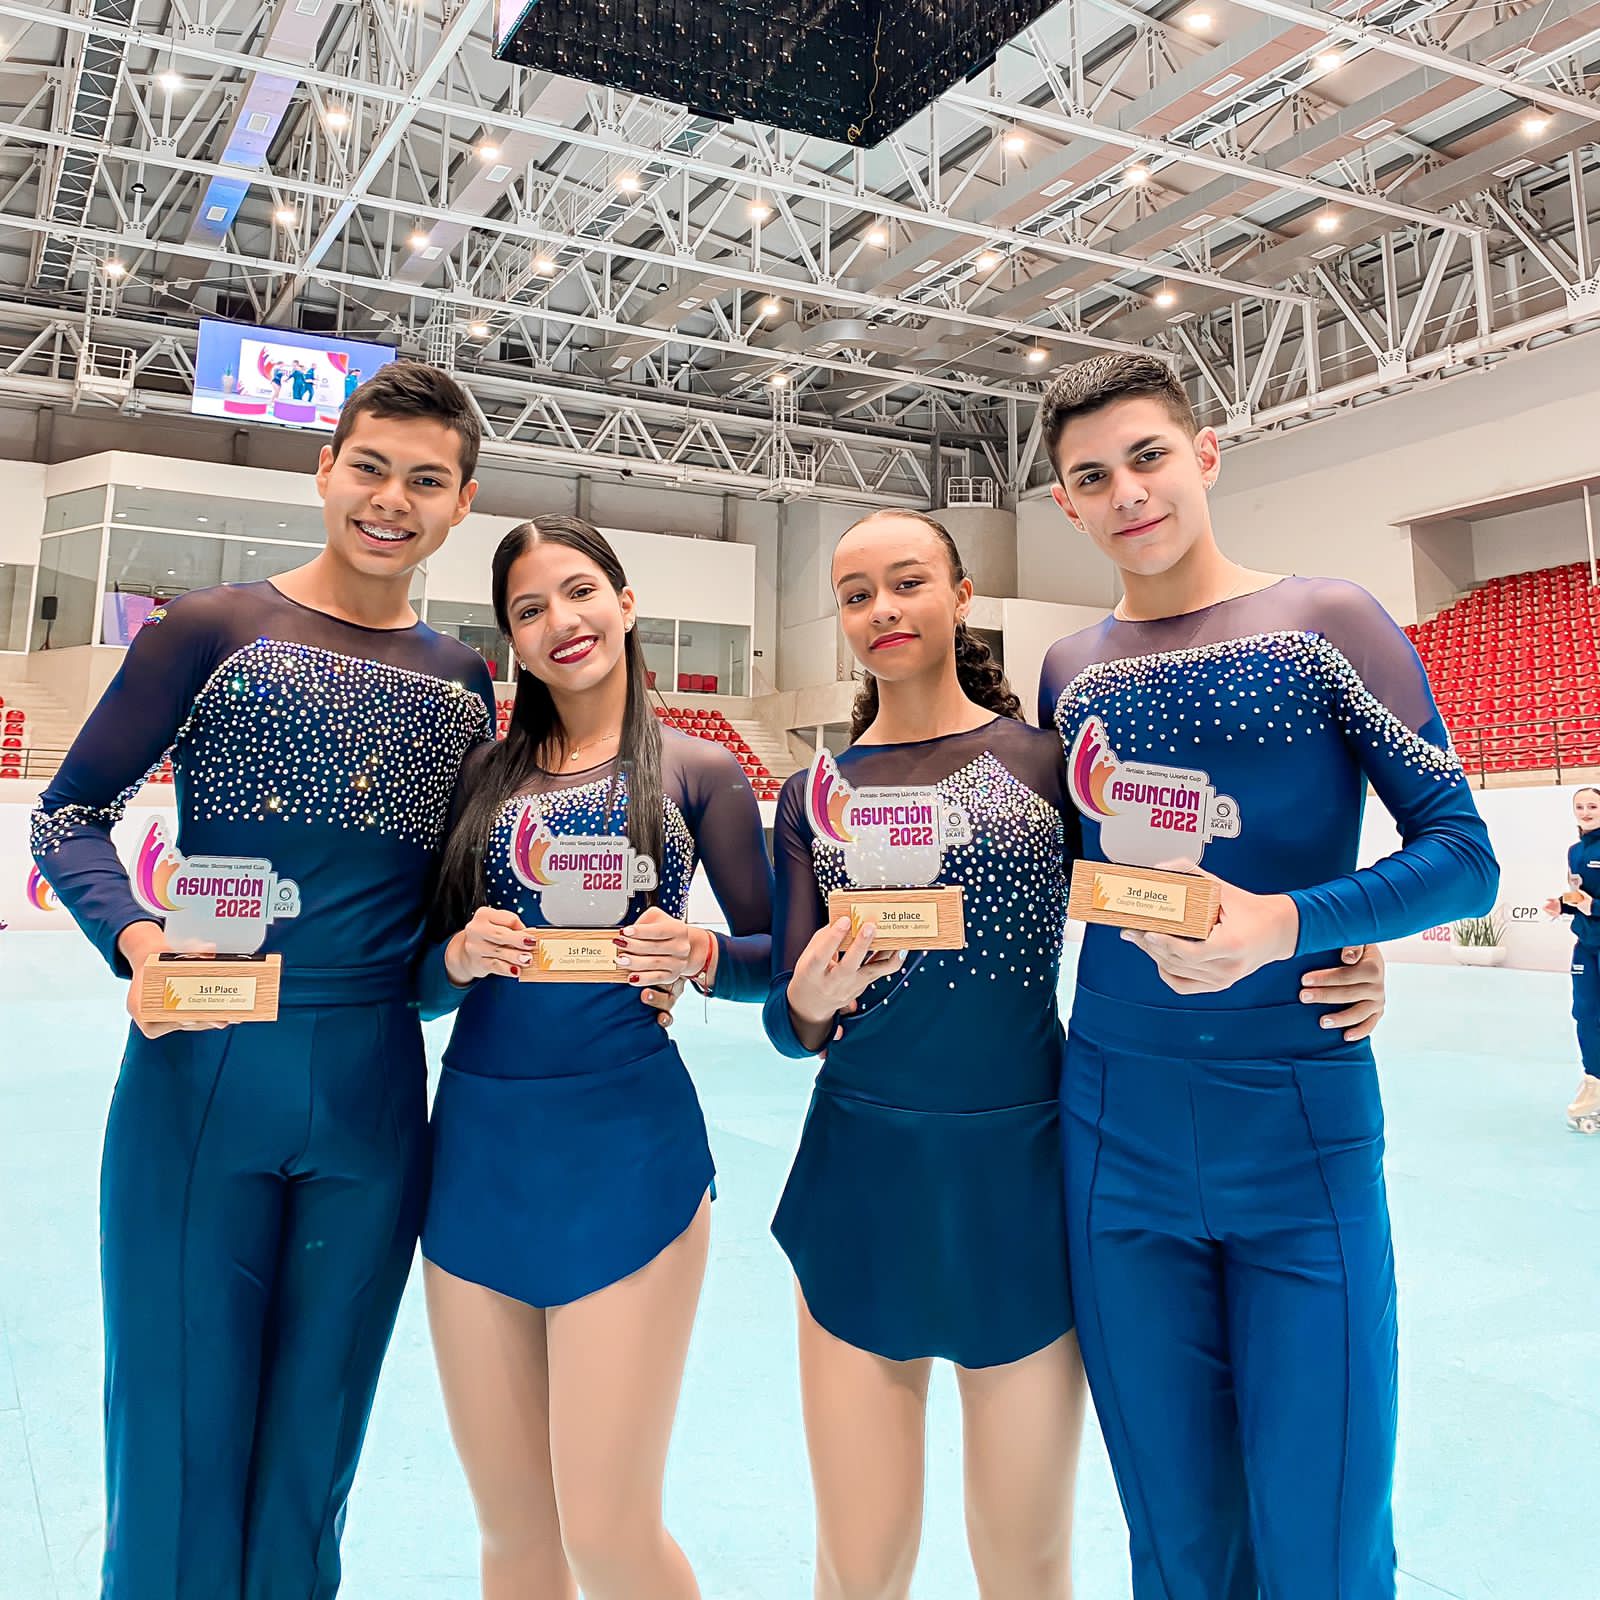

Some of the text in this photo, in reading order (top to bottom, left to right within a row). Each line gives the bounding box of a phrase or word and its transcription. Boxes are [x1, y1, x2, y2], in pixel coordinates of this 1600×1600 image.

[1146, 770, 1168, 778] Skating
[1150, 808, 1198, 833] 2022
[1210, 822, 1233, 830] SKATE
[889, 826, 934, 847] 2022
[582, 873, 622, 890] 2022
[1127, 886, 1168, 901] 3rd place
[215, 899, 261, 918] 2022
[1512, 907, 1538, 919] CPP
[882, 911, 921, 922] 3rd place
[1422, 926, 1450, 941] 2022
[568, 947, 602, 955] 1st Place
[199, 985, 238, 994] 1st Place
